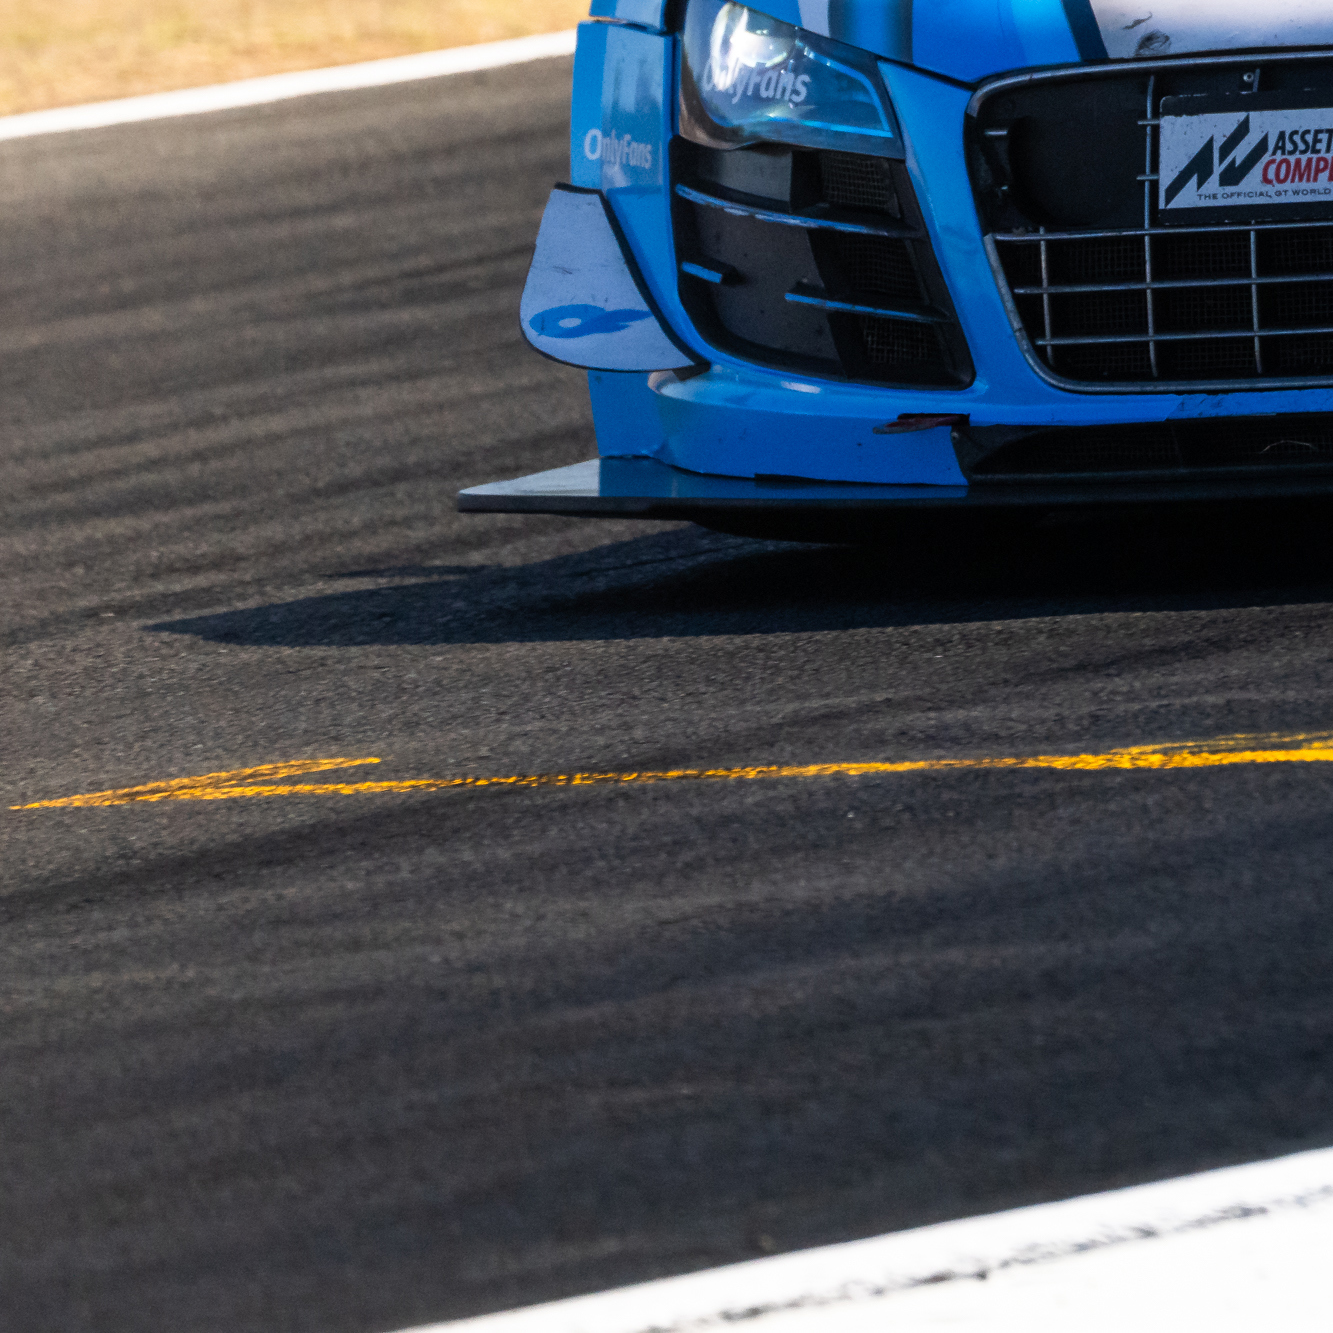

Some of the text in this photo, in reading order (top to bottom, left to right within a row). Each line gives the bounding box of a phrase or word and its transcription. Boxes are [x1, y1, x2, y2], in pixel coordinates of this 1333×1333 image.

[702, 50, 812, 104] OyFans
[584, 128, 653, 169] OnlyFans
[1197, 193, 1218, 202] THE
[1221, 190, 1270, 200] OFFICIAL
[1274, 189, 1289, 198] GT
[1291, 187, 1332, 197] WORLD
